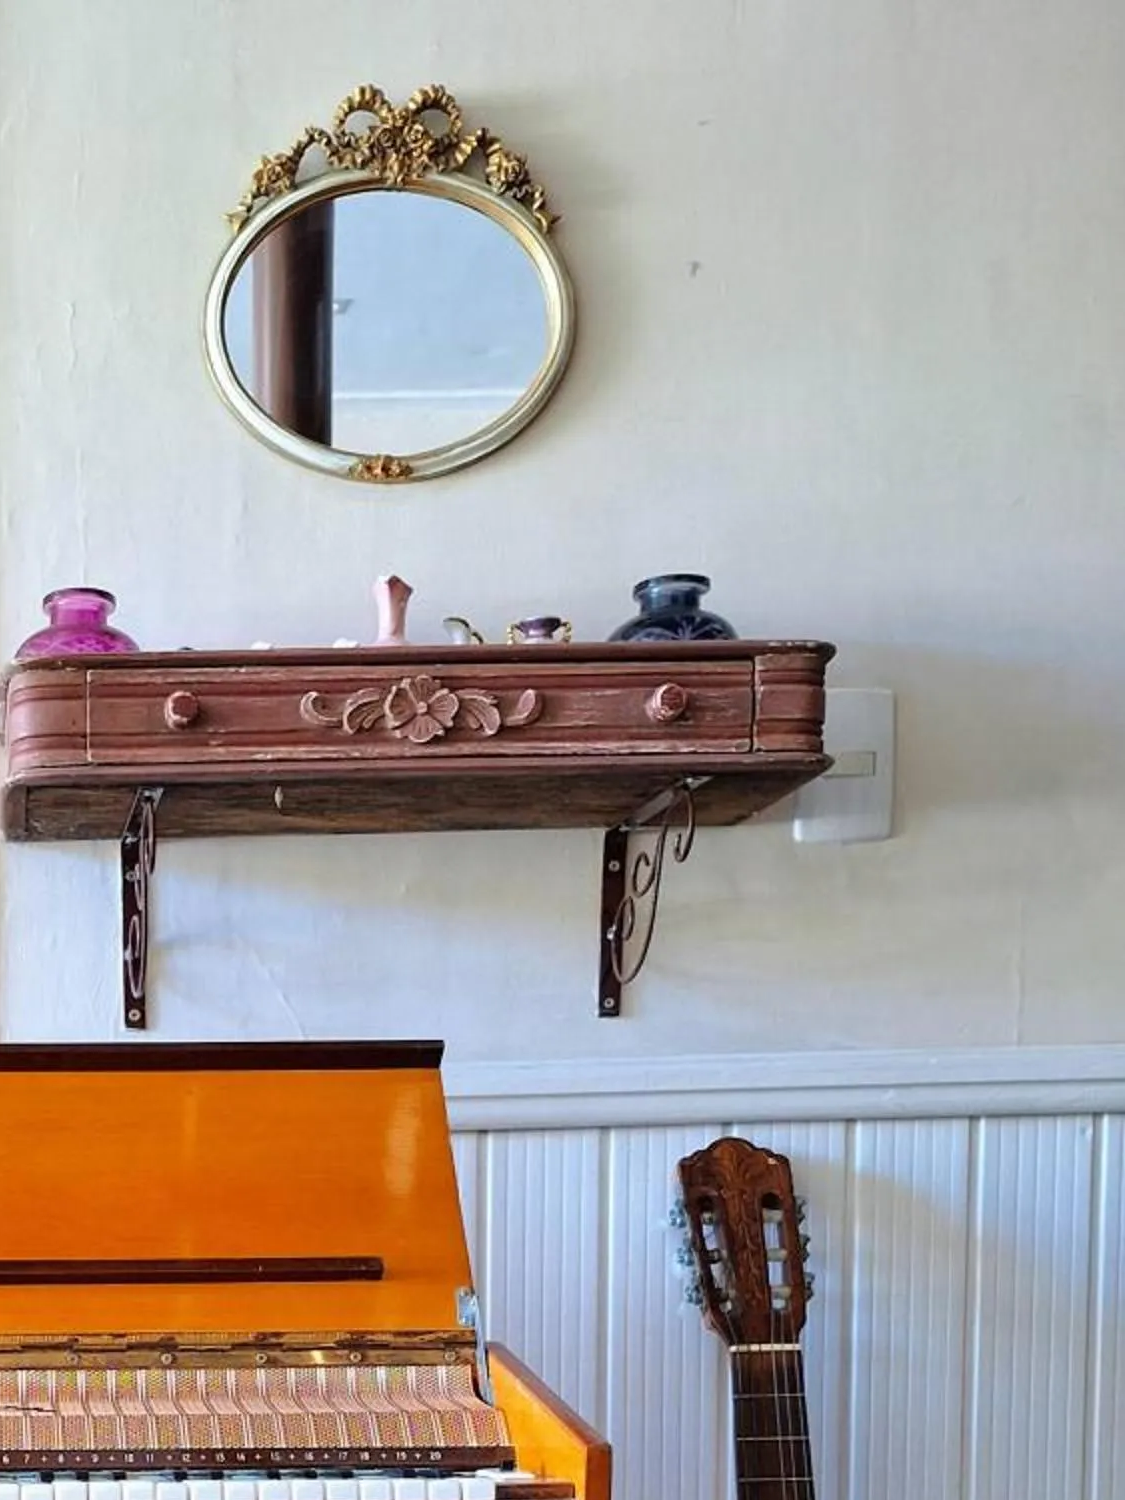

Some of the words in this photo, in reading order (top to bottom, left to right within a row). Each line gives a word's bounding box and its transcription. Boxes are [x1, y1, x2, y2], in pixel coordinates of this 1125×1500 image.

[146, 1453, 154, 1463] 11
[182, 1453, 191, 1463] 12
[270, 1451, 281, 1462] 15
[338, 1451, 348, 1461] 17
[396, 1451, 407, 1461] 19
[429, 1451, 442, 1461] 20
